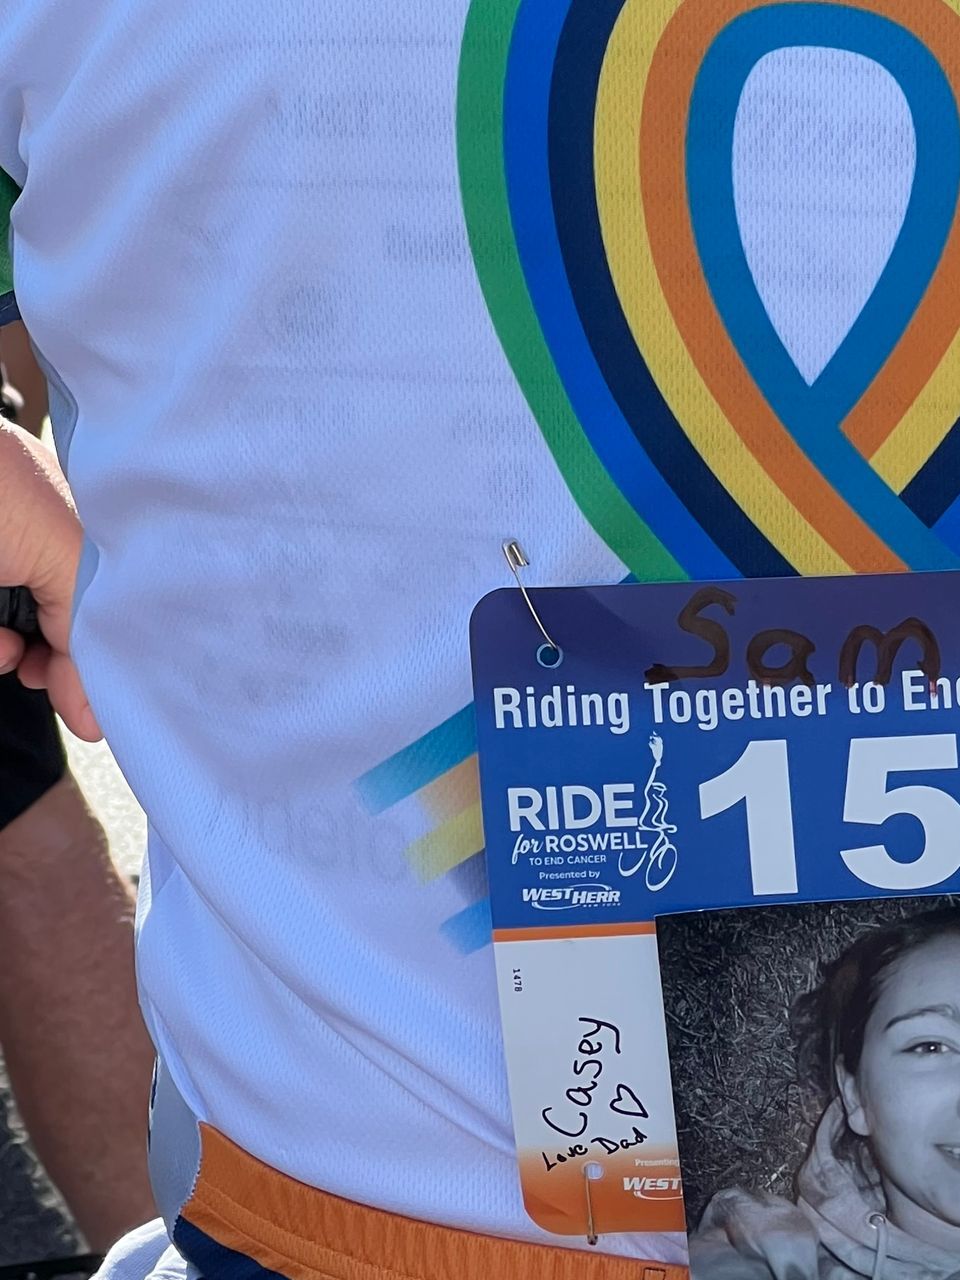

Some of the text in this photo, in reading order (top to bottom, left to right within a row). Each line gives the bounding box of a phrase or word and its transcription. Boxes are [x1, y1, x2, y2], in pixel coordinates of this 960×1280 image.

[644, 586, 941, 688] Sam
[494, 684, 631, 734] Riding
[644, 678, 832, 730] Together
[848, 681, 886, 714] to
[507, 783, 639, 832] RIDE
[512, 831, 649, 865] for ROSWELL
[529, 854, 607, 866] TO END CANCER
[539, 870, 600, 880] Presented by
[542, 1126, 648, 1172] Love Dad
